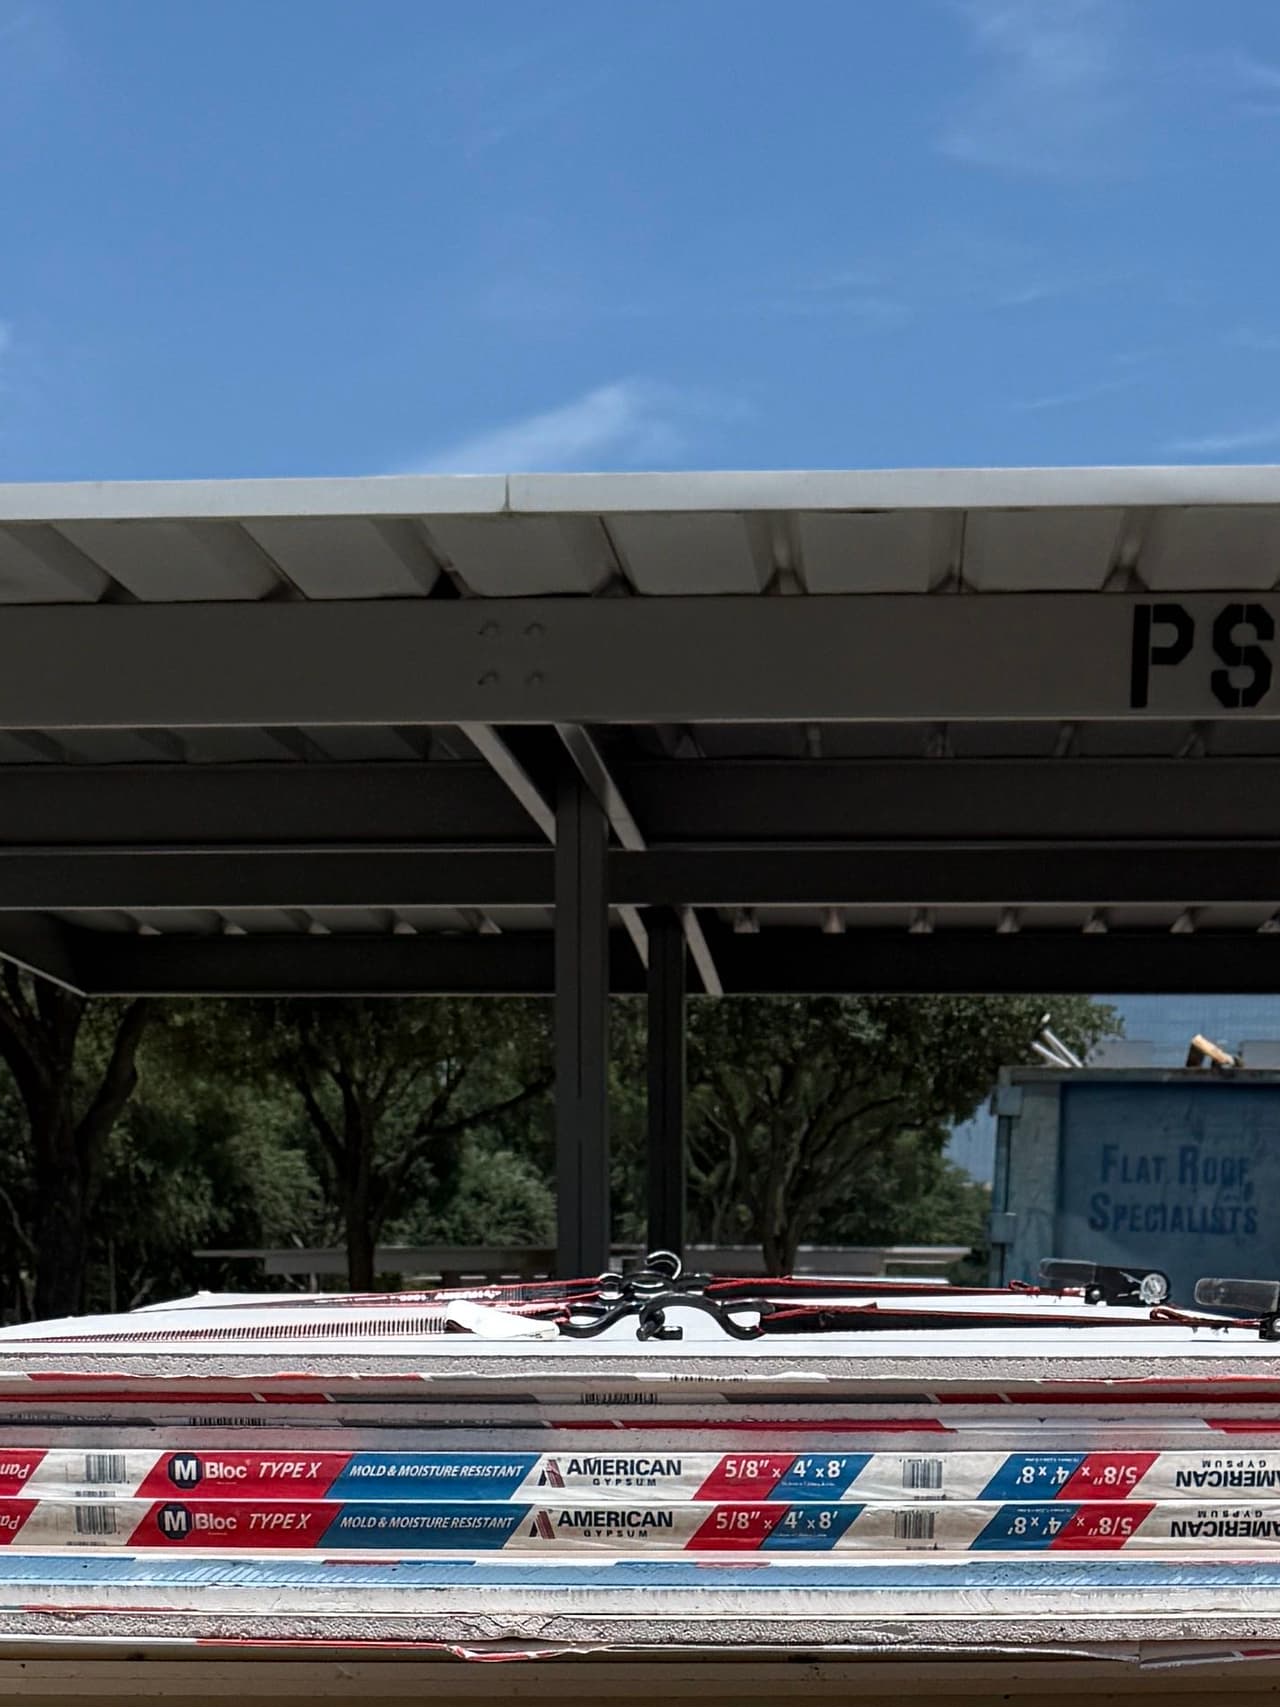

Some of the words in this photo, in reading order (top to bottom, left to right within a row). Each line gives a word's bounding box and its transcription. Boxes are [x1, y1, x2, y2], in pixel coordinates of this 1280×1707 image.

[1130, 604, 1275, 708] PS
[1087, 1192, 1258, 1234] SPECIALISTS
[259, 1462, 306, 1478] TYPE
[306, 1462, 322, 1478] X
[567, 1458, 681, 1476] AMERICAN
[1202, 1460, 1266, 1468] GYPSUM
[349, 1465, 386, 1476] MOLD
[387, 1465, 397, 1476] &
[397, 1465, 460, 1477] MOISTURE
[459, 1465, 524, 1477] RESISTANT
[772, 1468, 781, 1478] x
[816, 1468, 824, 1477] x
[1038, 1466, 1047, 1476] x
[1081, 1467, 1090, 1476] x
[592, 1478, 656, 1486] GYPSUM
[557, 1511, 673, 1528] AMERICAN
[1197, 1510, 1263, 1518] GYPSUM
[250, 1513, 296, 1529] TYPE
[296, 1513, 312, 1529] X
[340, 1516, 377, 1528] MOLD
[378, 1517, 388, 1528] &
[388, 1517, 451, 1528] MOISTURE
[450, 1517, 515, 1528] RESISTANT
[583, 1529, 648, 1538] GYPSUM
